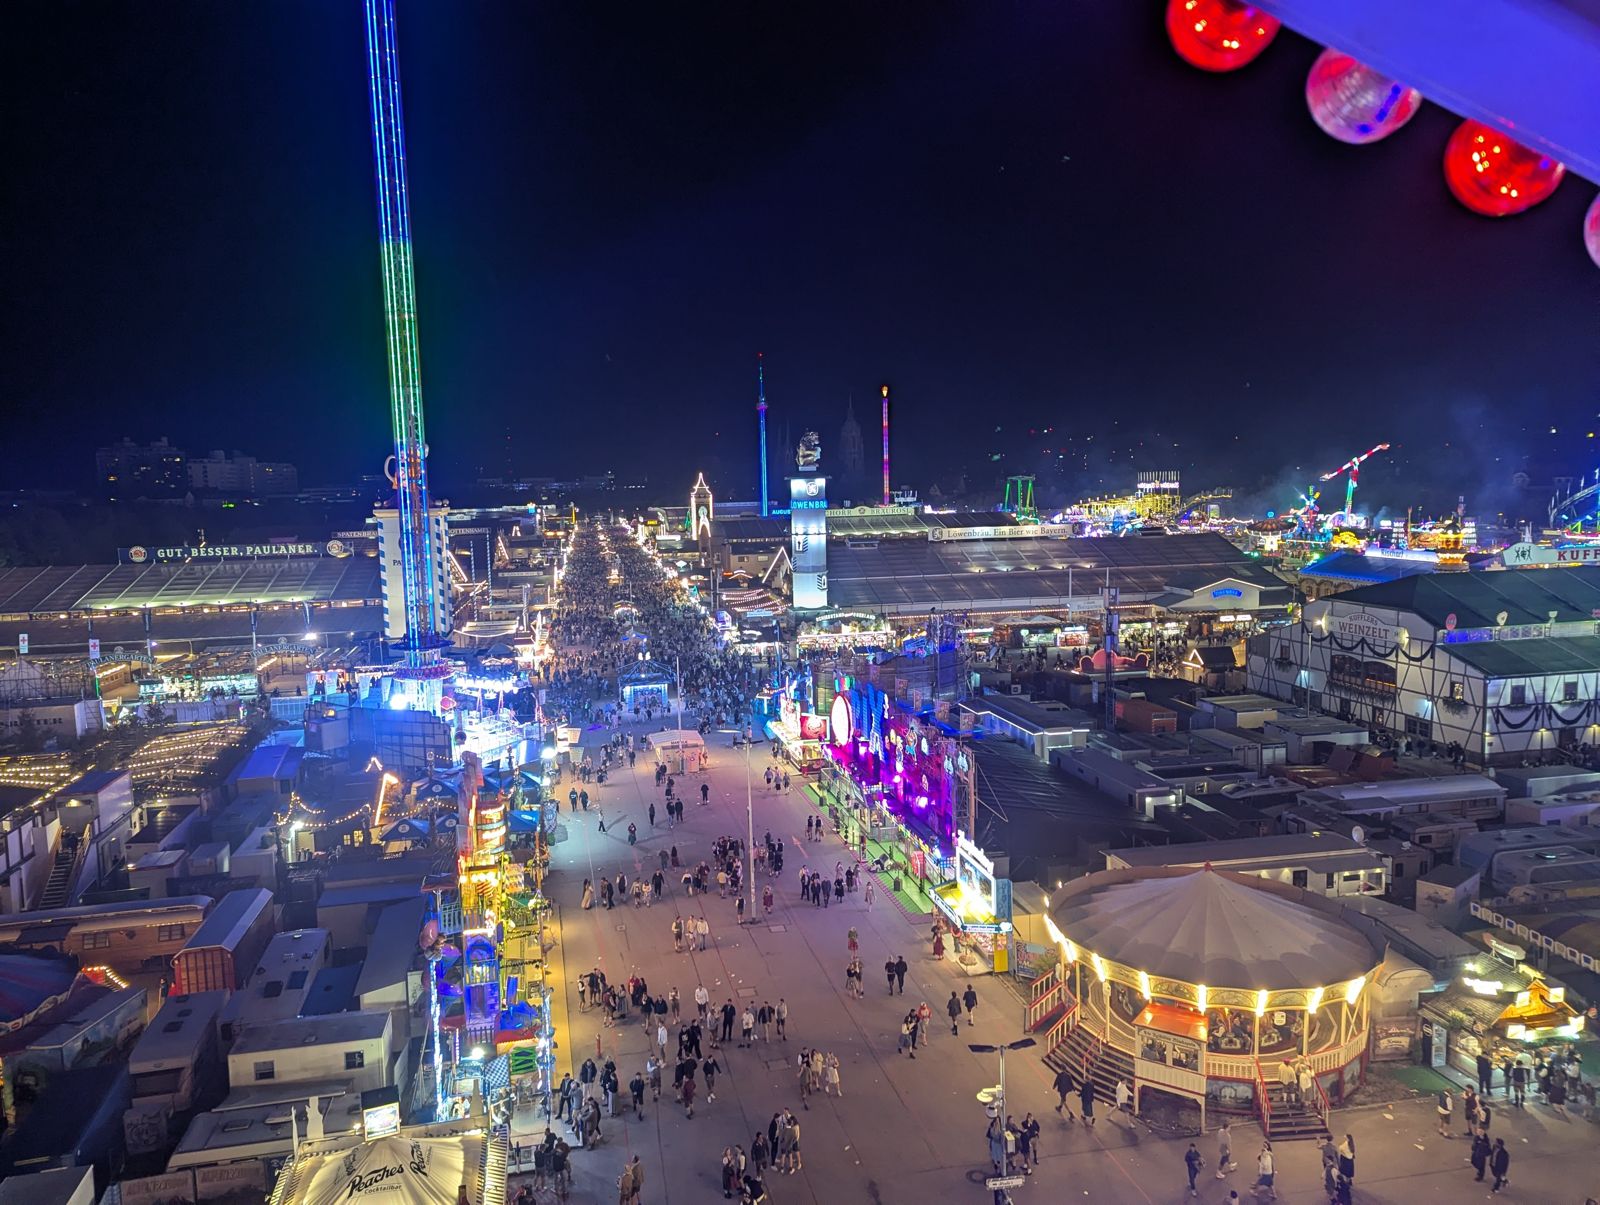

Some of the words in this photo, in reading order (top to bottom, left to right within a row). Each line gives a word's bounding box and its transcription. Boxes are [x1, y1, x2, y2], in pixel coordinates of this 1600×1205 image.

[1008, 528, 1024, 536] Bier
[191, 546, 244, 557] BESSER,
[246, 544, 318, 555] PAULANER.
[1338, 621, 1390, 640] WEINZELT
[346, 1163, 405, 1199] Peaches
[364, 1184, 402, 1195] Cocktailbar
